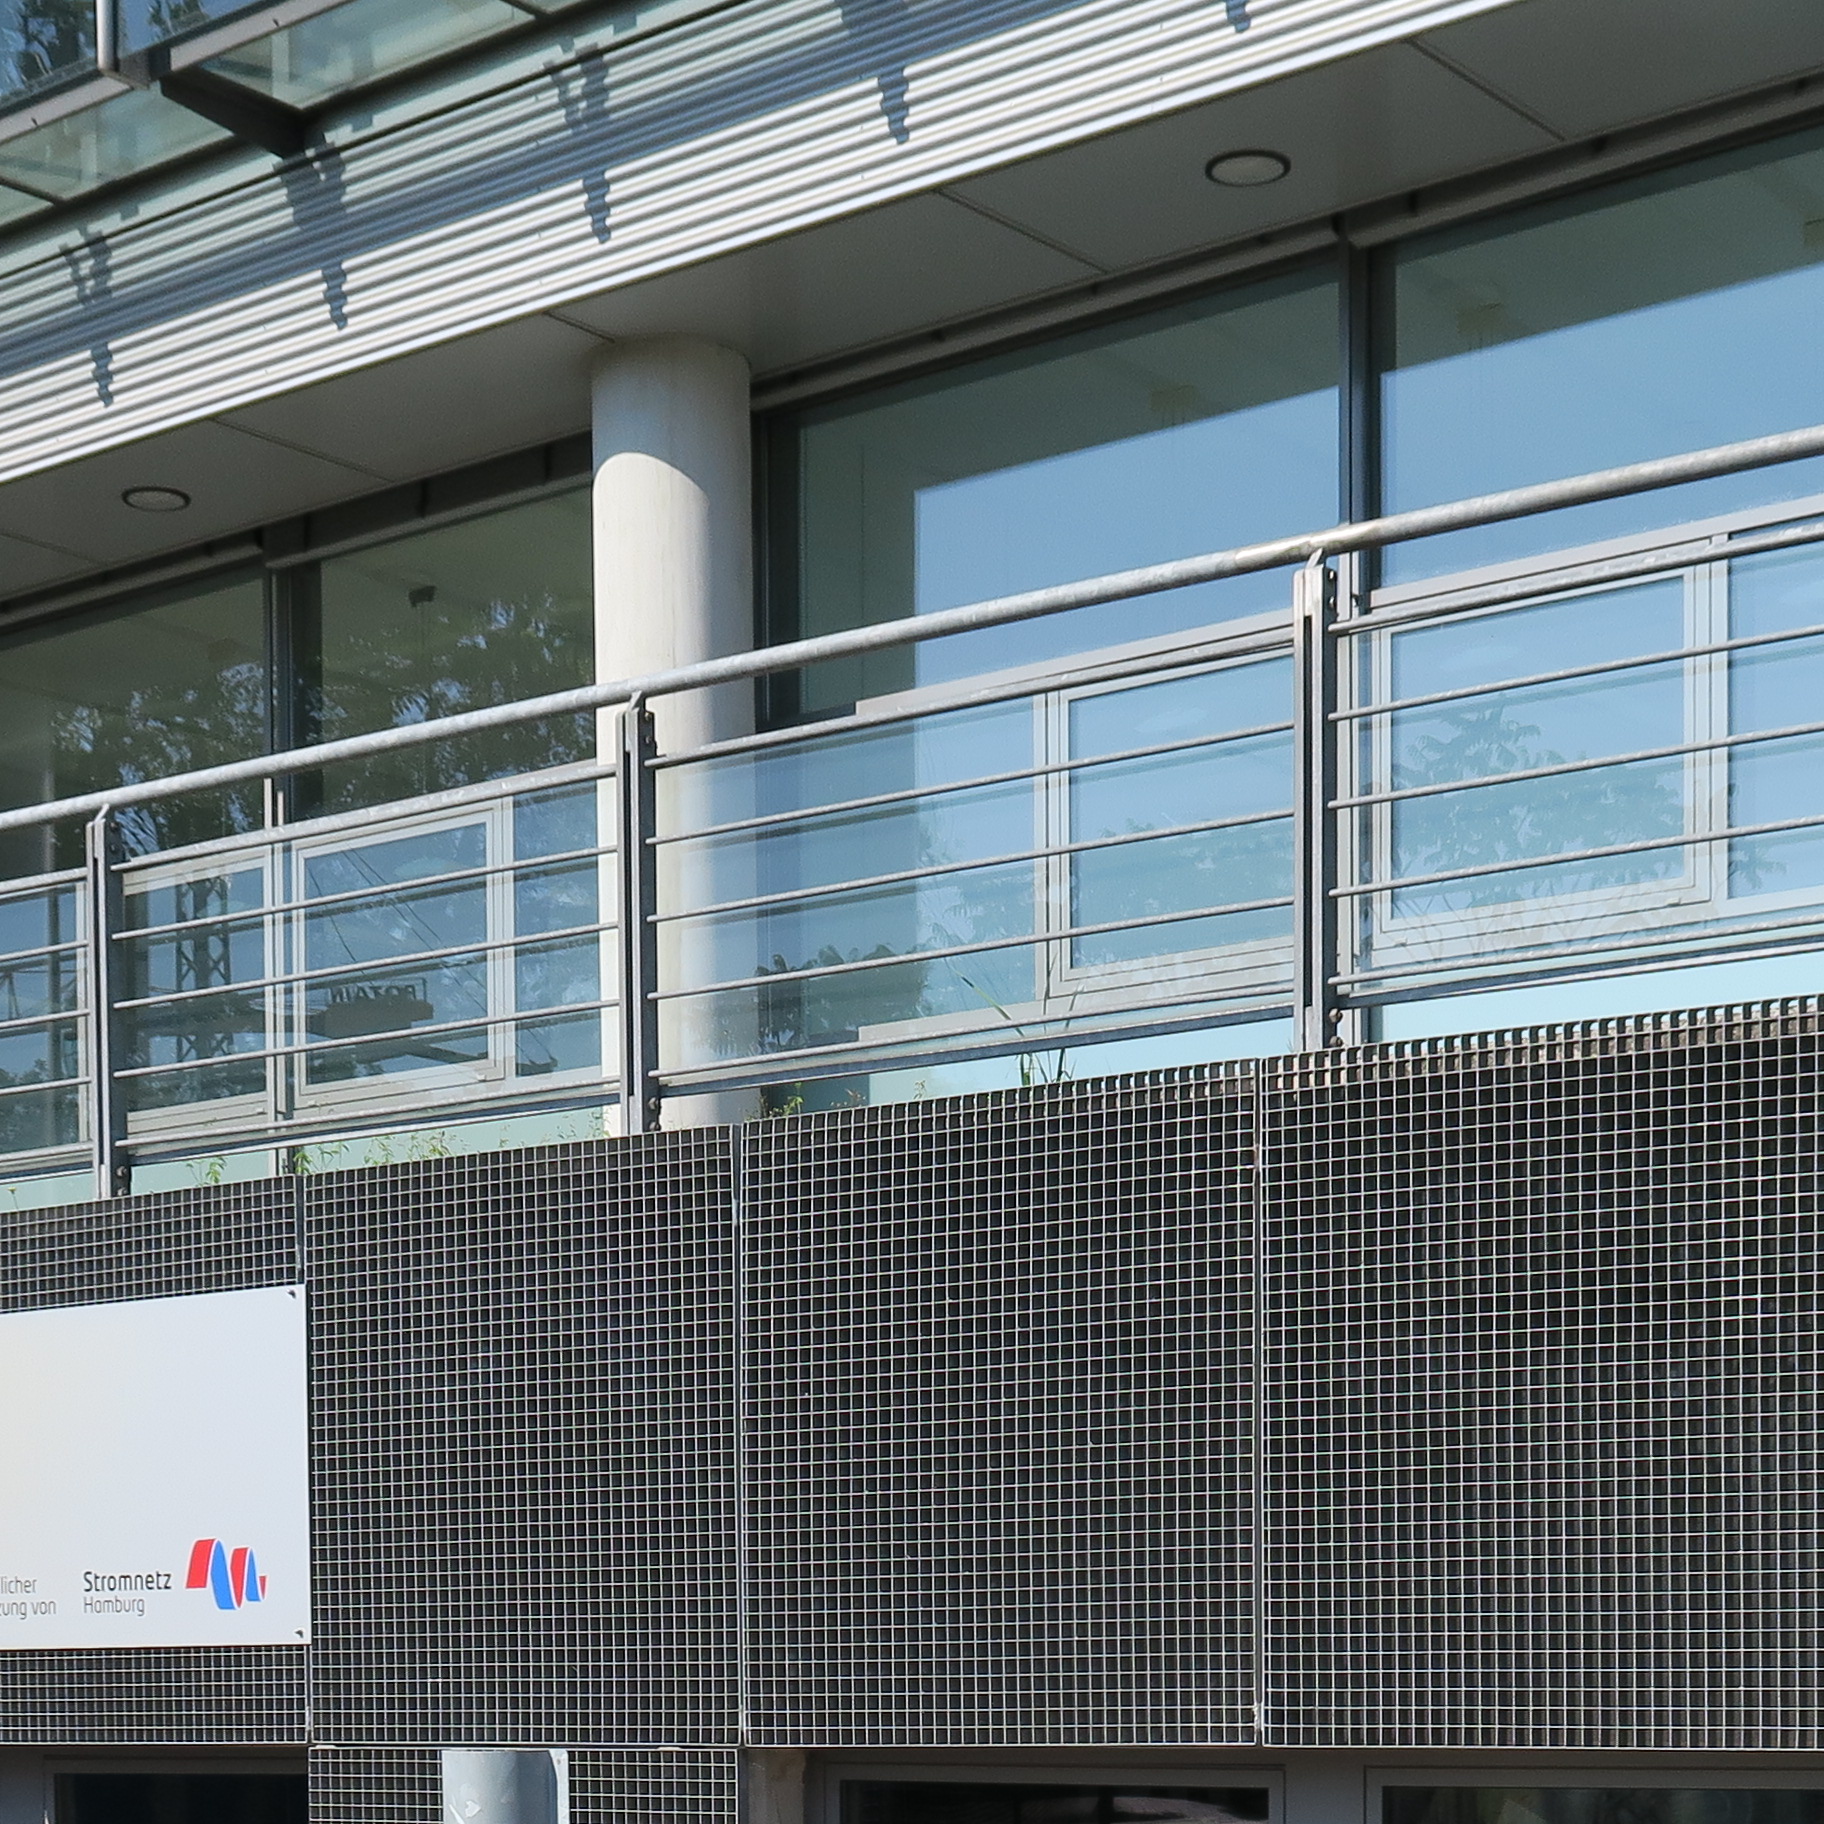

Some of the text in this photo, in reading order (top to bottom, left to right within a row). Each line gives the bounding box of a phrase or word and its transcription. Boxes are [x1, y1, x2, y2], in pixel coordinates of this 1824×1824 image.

[83, 1570, 173, 1593] Stromnetz
[32, 1600, 57, 1616] von
[83, 1595, 146, 1618] Hamburg
